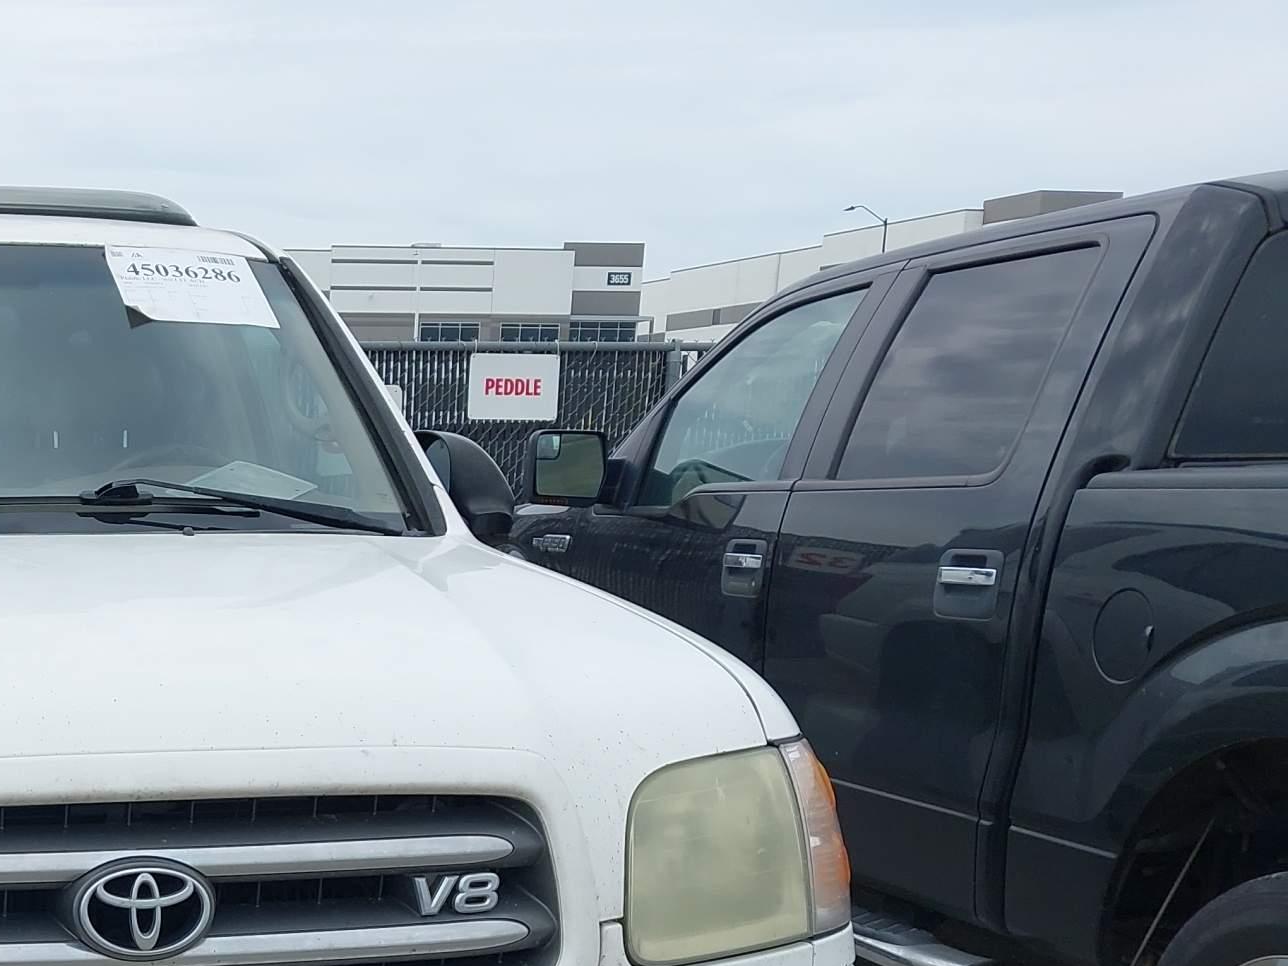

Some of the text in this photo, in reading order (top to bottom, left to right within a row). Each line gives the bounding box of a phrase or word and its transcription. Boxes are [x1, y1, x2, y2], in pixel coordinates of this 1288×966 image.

[127, 263, 241, 283] 45036286
[610, 274, 629, 284] 3655
[485, 378, 541, 396] PEDDLE
[414, 872, 501, 916] V8
